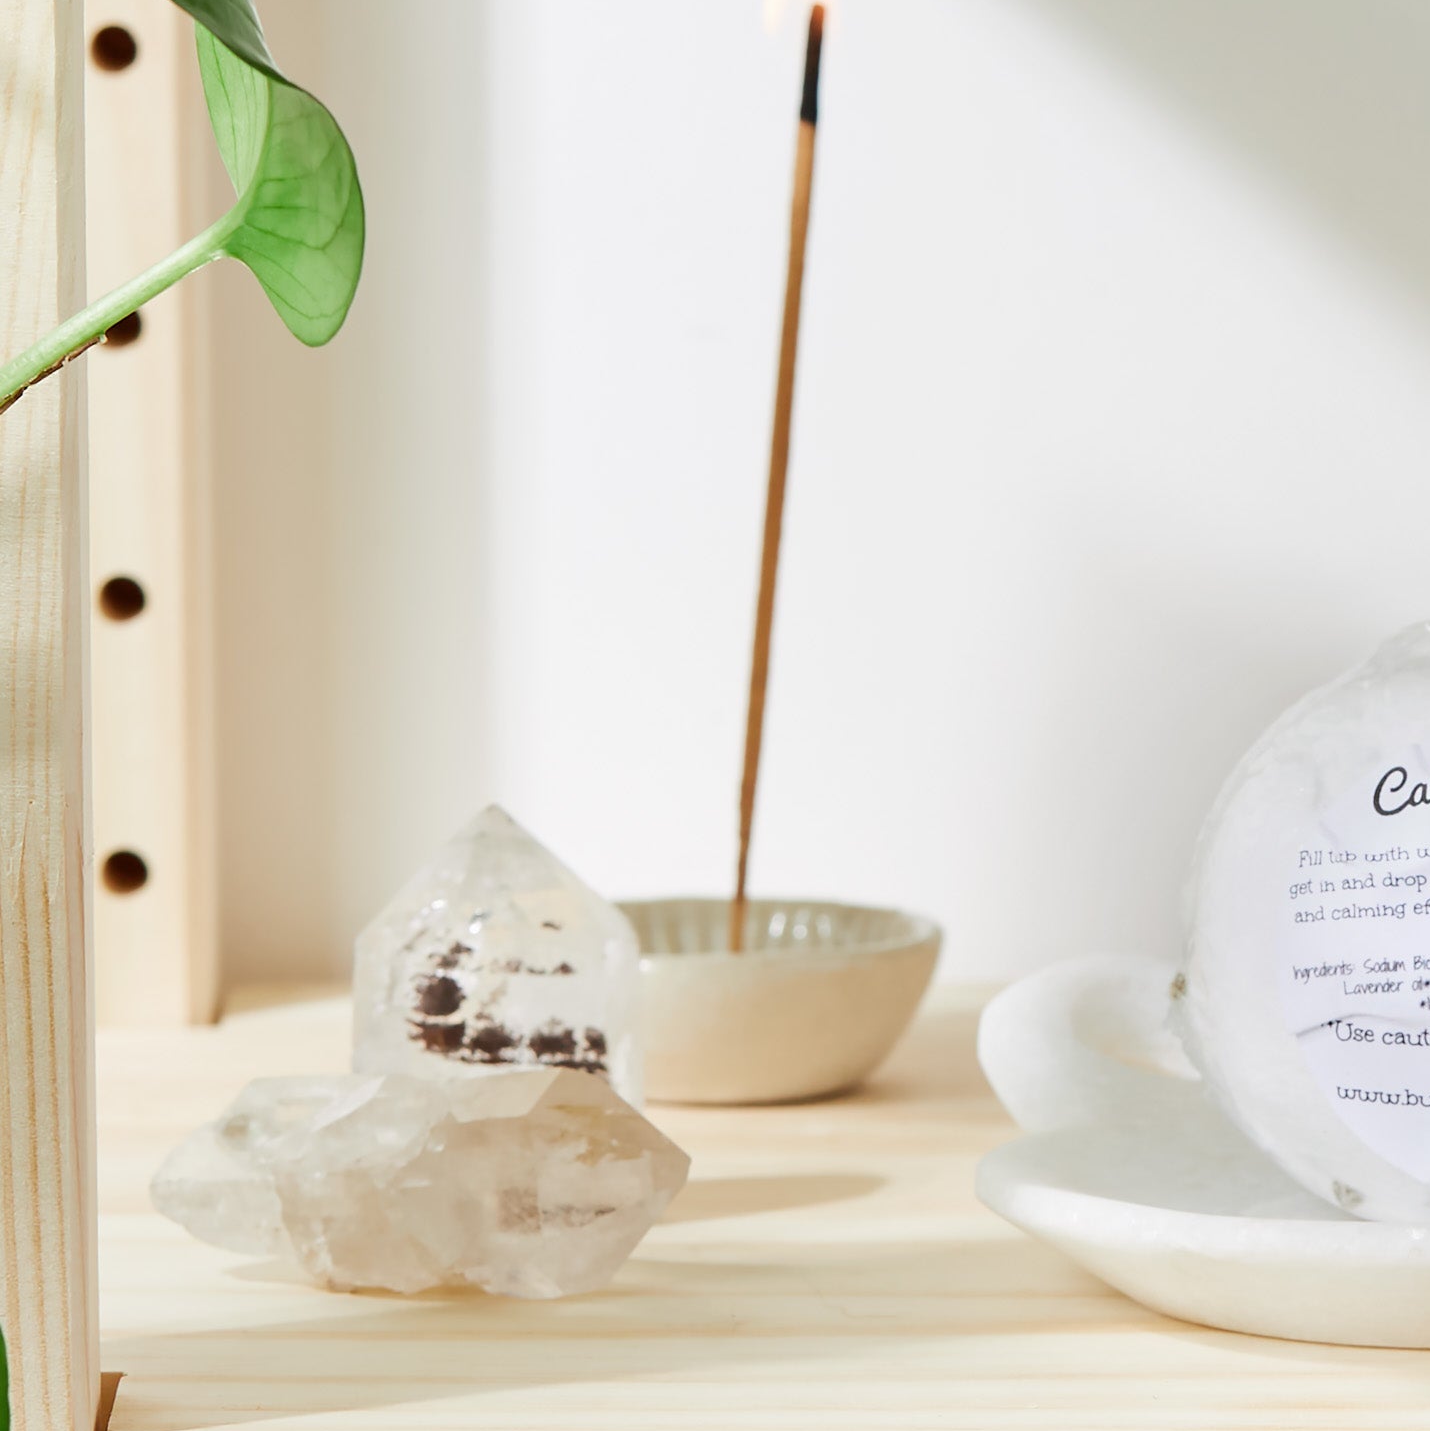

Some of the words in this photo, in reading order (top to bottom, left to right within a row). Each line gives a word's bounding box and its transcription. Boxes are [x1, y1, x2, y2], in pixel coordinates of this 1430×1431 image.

[1298, 849, 1323, 867] Fill
[1329, 850, 1357, 864] tub
[1364, 846, 1409, 862] with
[1289, 878, 1313, 900] get
[1320, 880, 1335, 893] in
[1341, 872, 1375, 891] and
[1382, 872, 1427, 892] drop
[1294, 906, 1325, 923] and
[1331, 903, 1407, 920] calming
[1363, 957, 1405, 974] Sodium
[1343, 980, 1404, 996] Lavender
